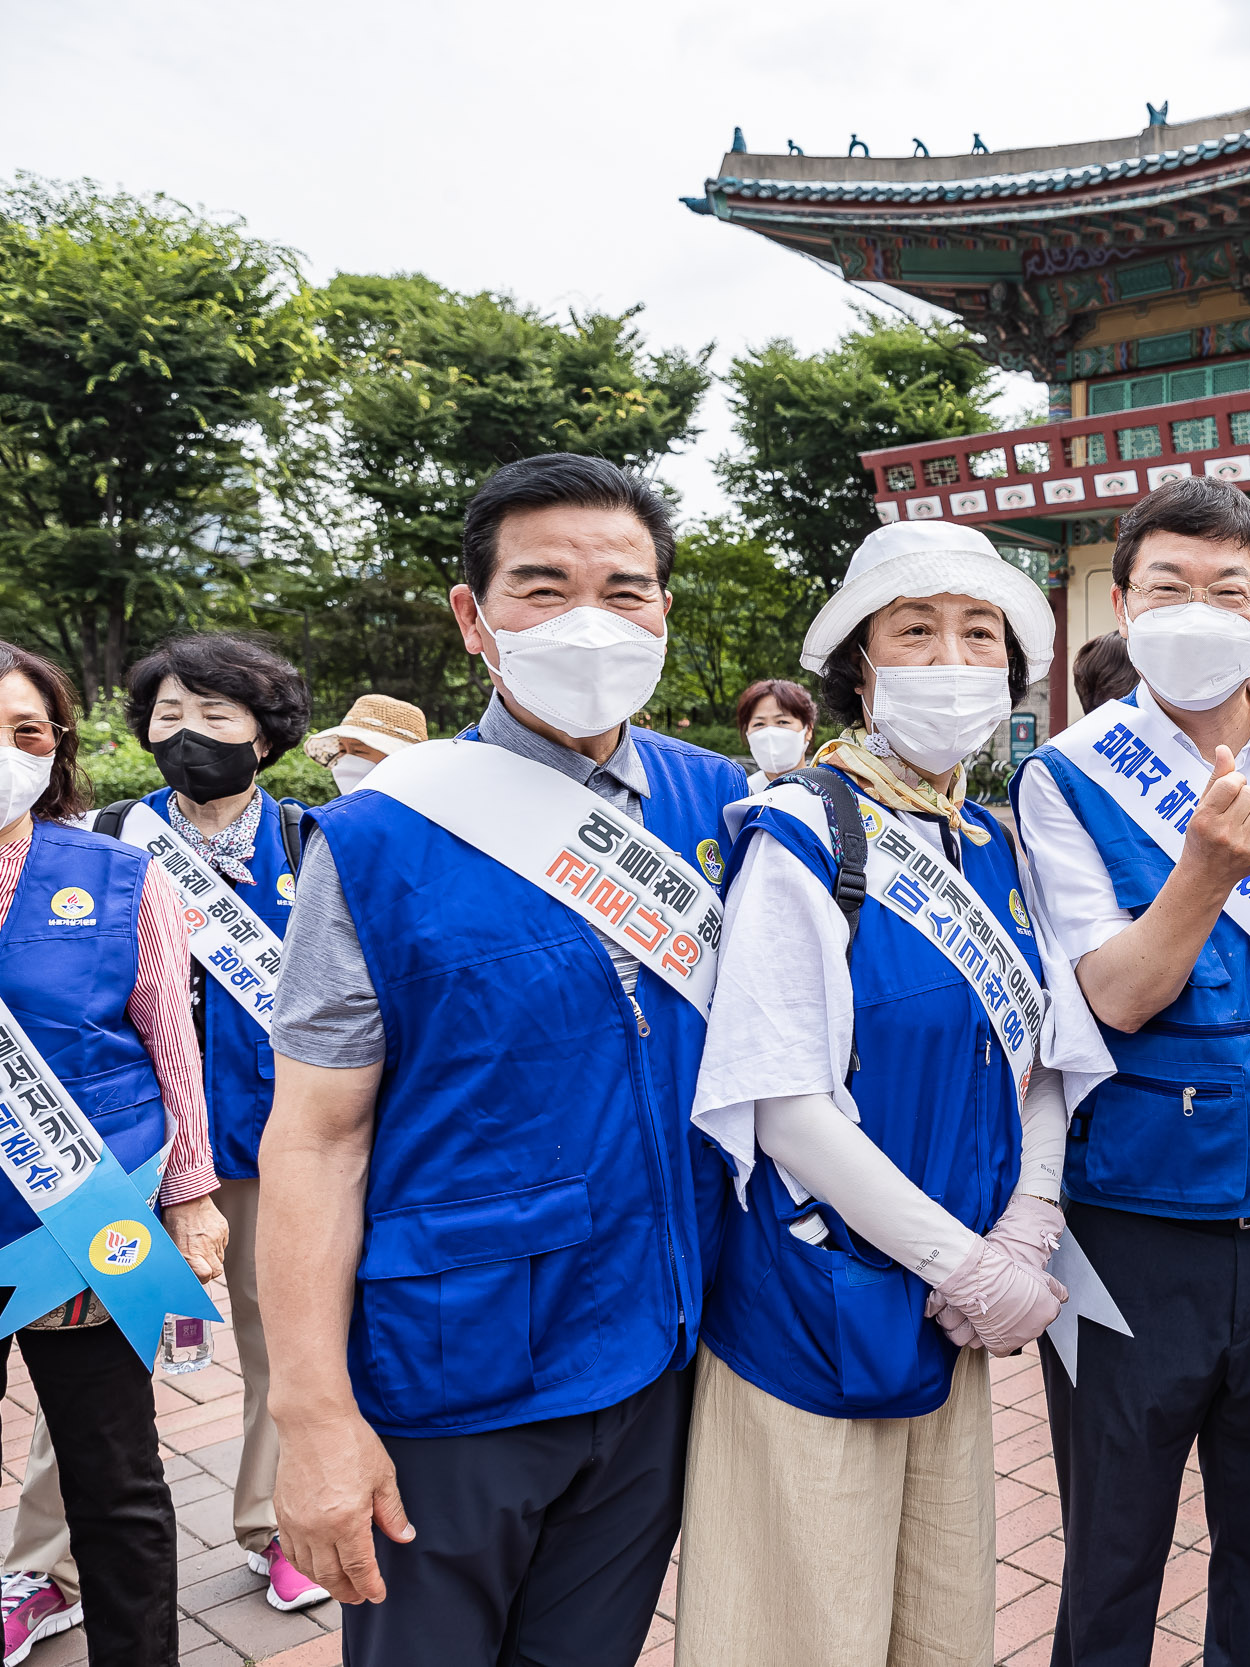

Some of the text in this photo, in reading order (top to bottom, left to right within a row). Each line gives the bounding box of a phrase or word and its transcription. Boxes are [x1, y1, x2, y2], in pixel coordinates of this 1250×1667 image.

[1092, 722, 1172, 797] 법질서
[147, 835, 214, 897] 여름철
[207, 897, 261, 946] 행락
[545, 849, 700, 978] 코로나19
[578, 811, 697, 914] 여름철
[208, 944, 264, 993] 방역
[880, 827, 1041, 1050] 바르게살기운동
[887, 873, 1025, 1052] 마스크착용
